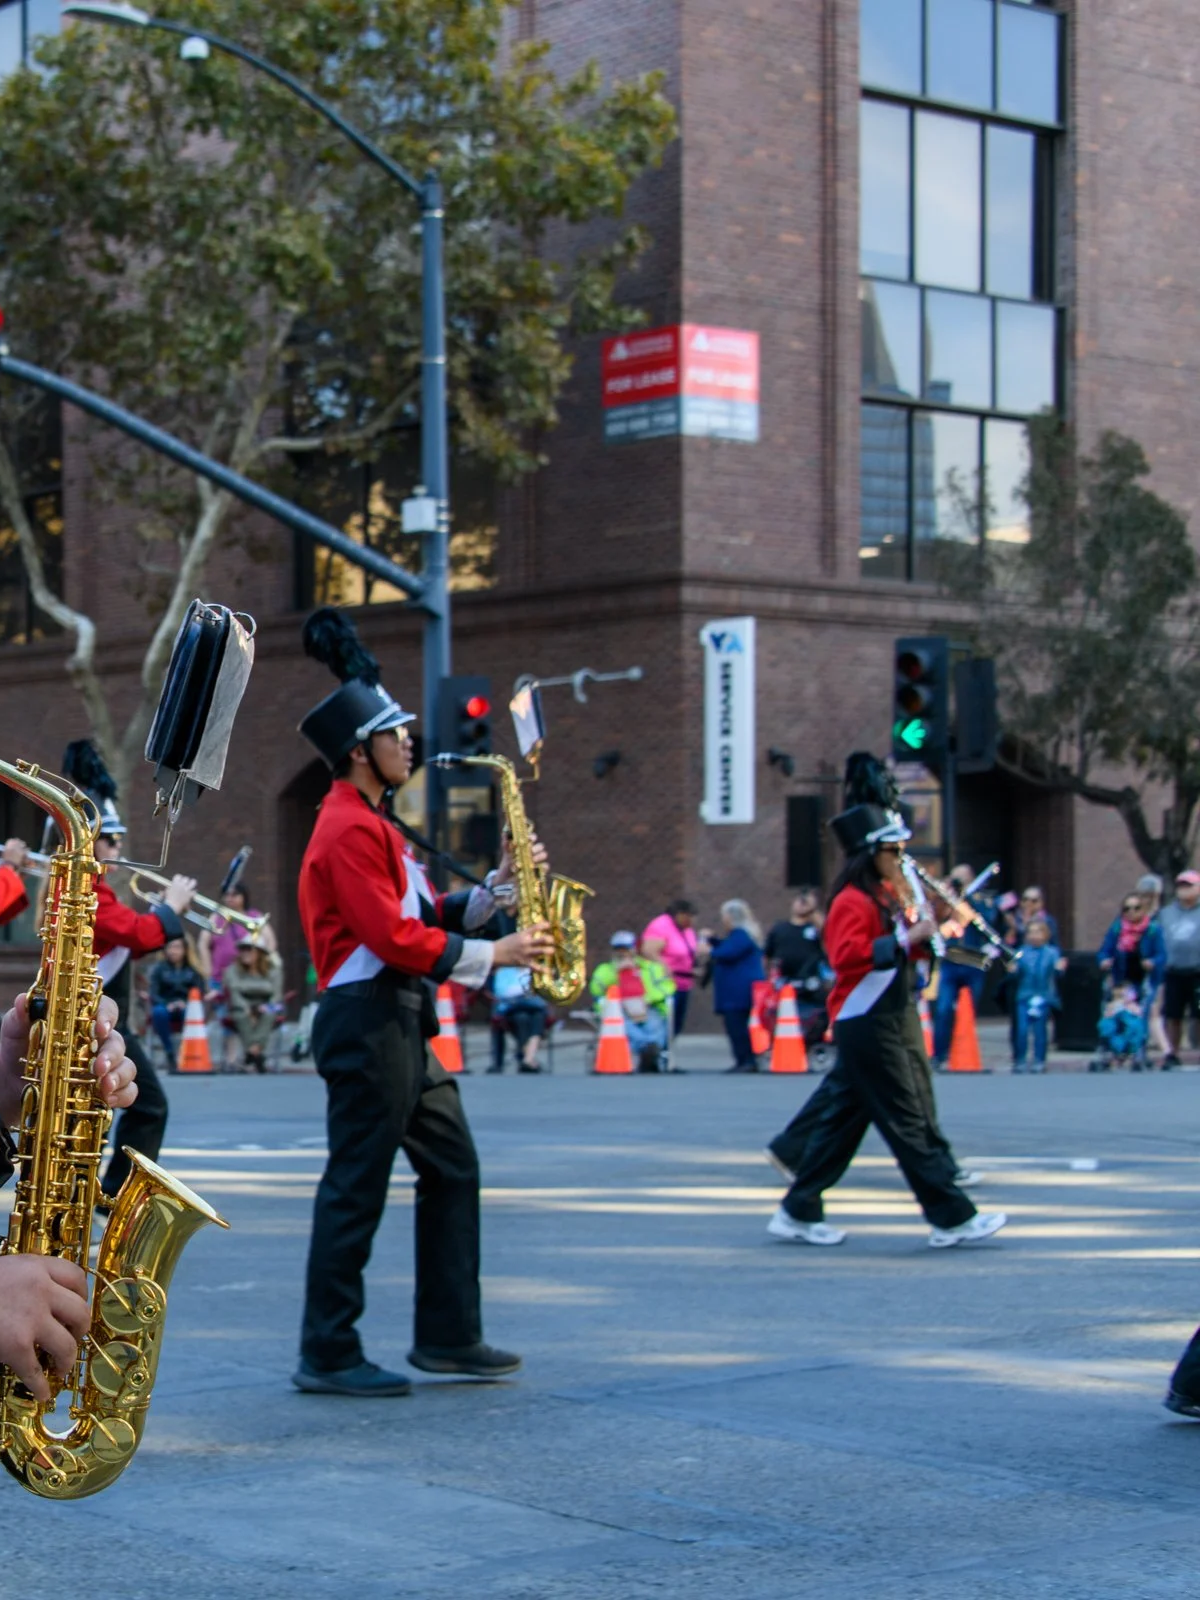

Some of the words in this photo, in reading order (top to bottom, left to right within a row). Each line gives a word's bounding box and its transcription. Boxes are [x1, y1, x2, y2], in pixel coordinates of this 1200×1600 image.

[607, 377, 632, 393] FOR
[635, 369, 675, 389] LEASE
[720, 662, 732, 736] SERVICE
[720, 745, 732, 815] CENTER
